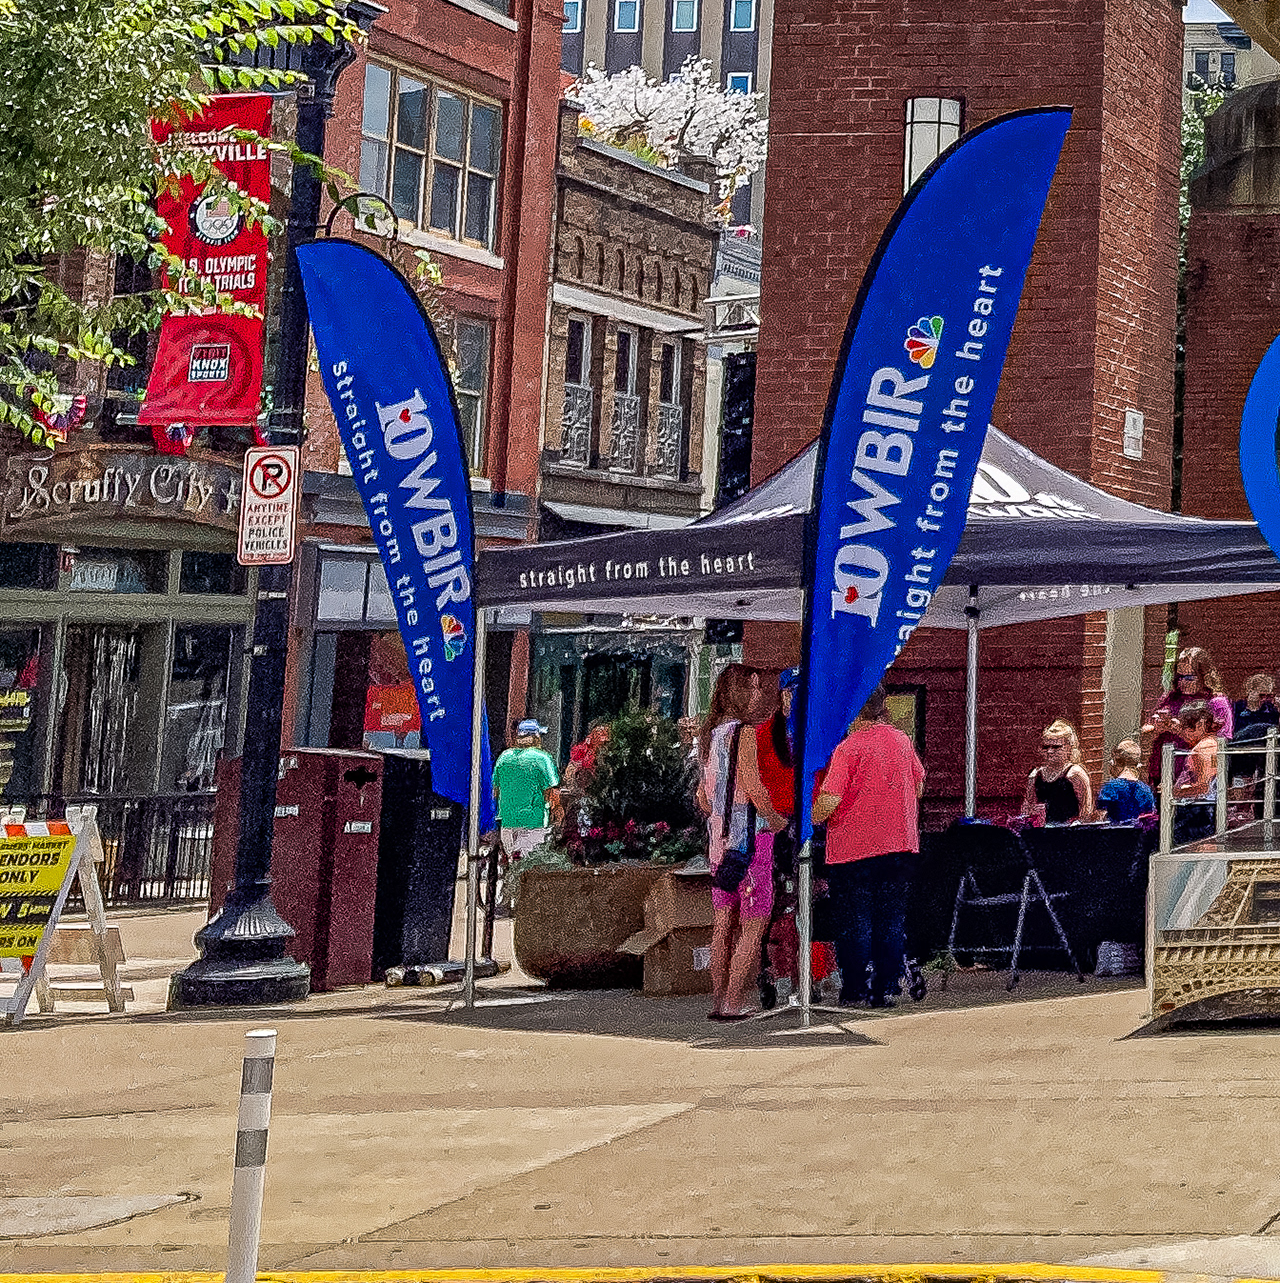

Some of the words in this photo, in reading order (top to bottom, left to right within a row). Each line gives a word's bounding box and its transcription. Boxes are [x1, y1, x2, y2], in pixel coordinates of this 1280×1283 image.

[205, 254, 257, 274] OLYMPIC
[215, 272, 255, 292] TRIALS
[956, 264, 1003, 360] heart
[192, 359, 226, 370] KNOX
[941, 374, 974, 433] the
[10, 466, 141, 518] Scruffy
[150, 463, 213, 512] City
[916, 449, 959, 533] from
[247, 502, 289, 513] ANYTIME
[248, 514, 286, 526] EXCEPT
[248, 527, 285, 538] POLICE
[333, 361, 379, 484] straight
[370, 492, 401, 564] from
[396, 574, 418, 626] the
[412, 636, 446, 722] heart
[244, 539, 288, 551] VEHICLES
[519, 563, 596, 589] straight
[605, 560, 649, 580] from
[658, 555, 689, 578] the
[700, 551, 754, 575] heart
[0, 852, 61, 866] ENDORS
[0, 869, 39, 884] ONLY
